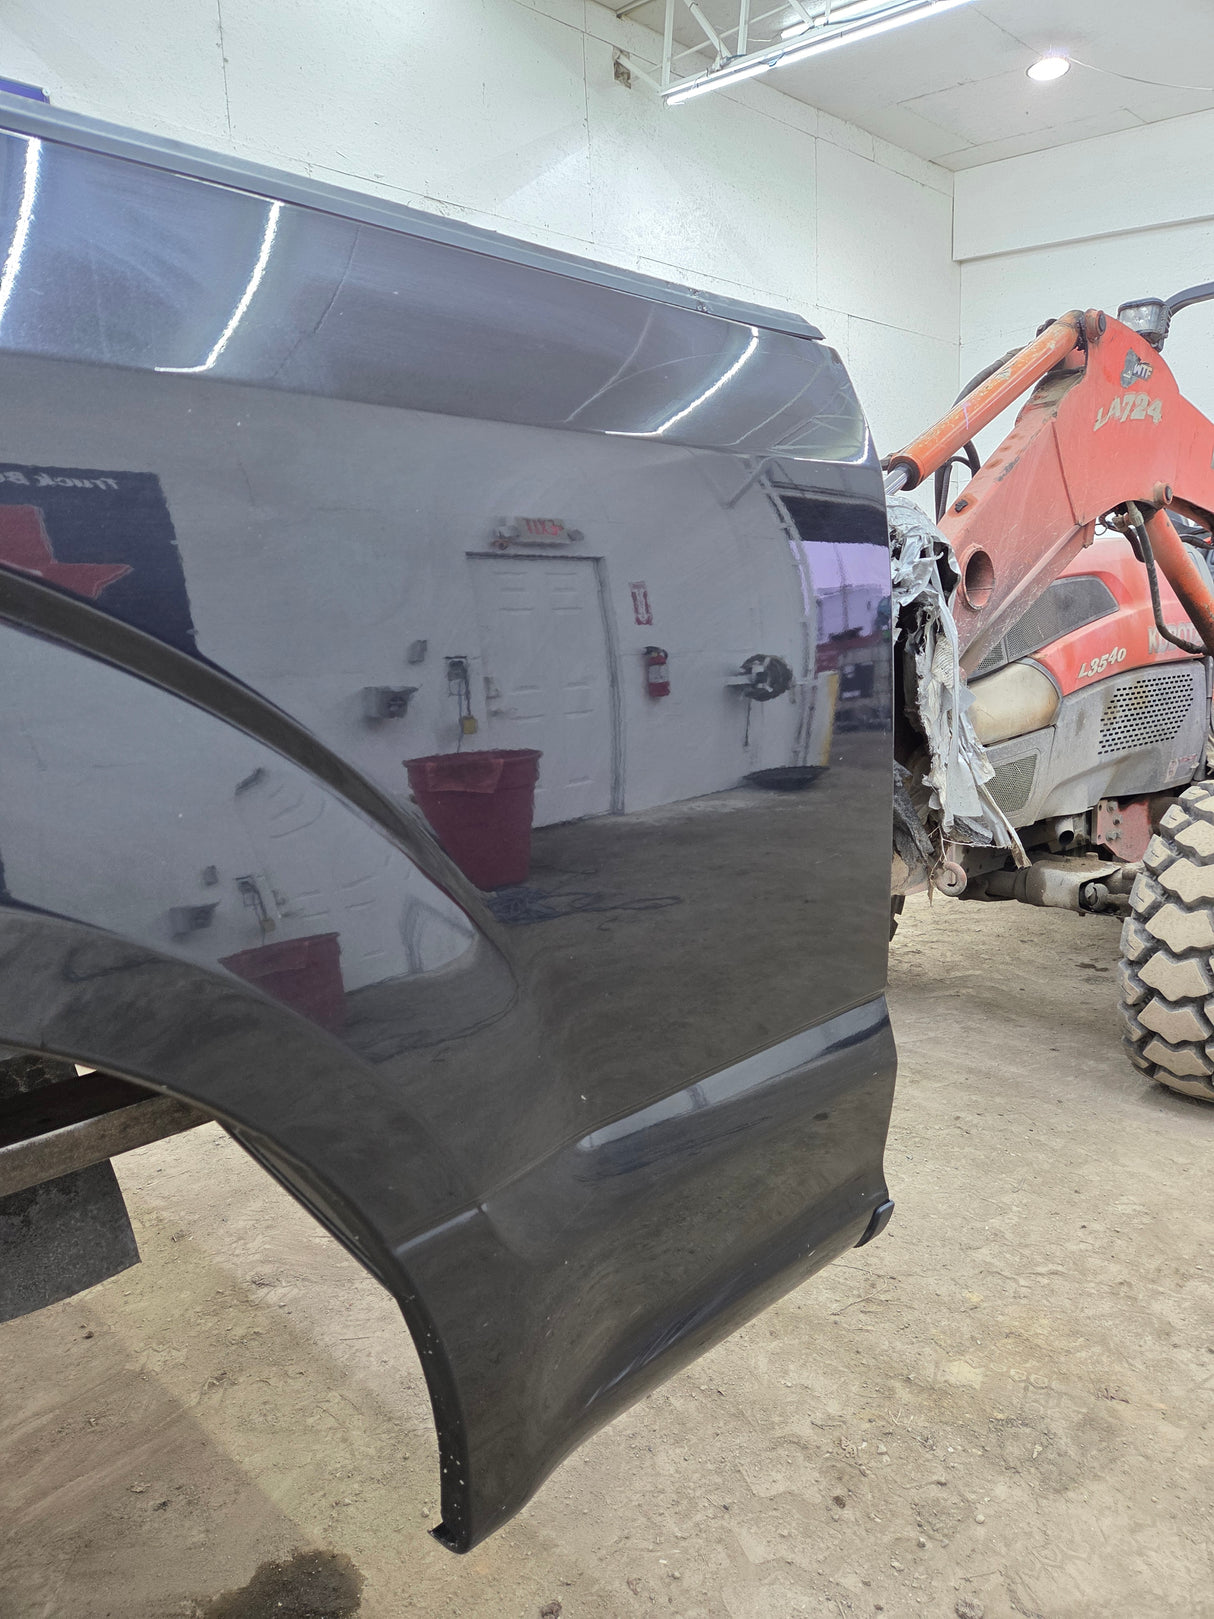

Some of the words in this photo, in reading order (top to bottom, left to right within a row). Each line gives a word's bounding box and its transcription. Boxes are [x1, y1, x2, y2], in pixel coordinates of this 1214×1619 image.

[1133, 363, 1153, 380] WTF
[1093, 391, 1163, 432] LA724
[1077, 646, 1127, 679] L3540
